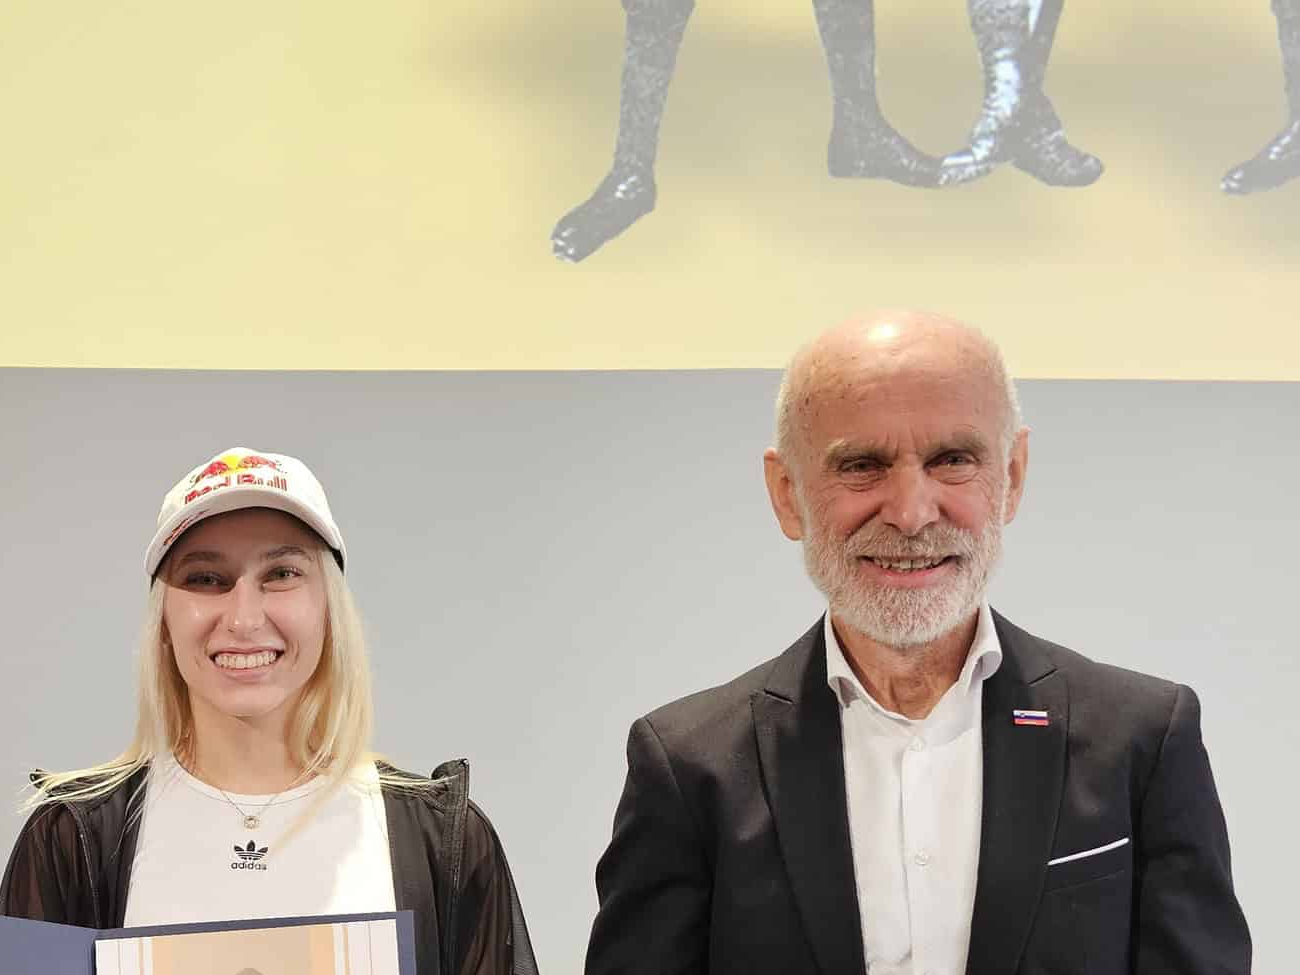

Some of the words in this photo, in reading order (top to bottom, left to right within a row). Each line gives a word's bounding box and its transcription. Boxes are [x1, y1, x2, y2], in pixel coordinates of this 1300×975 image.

[184, 475, 230, 505] Red
[236, 473, 288, 492] Bull
[230, 860, 268, 871] adidas
